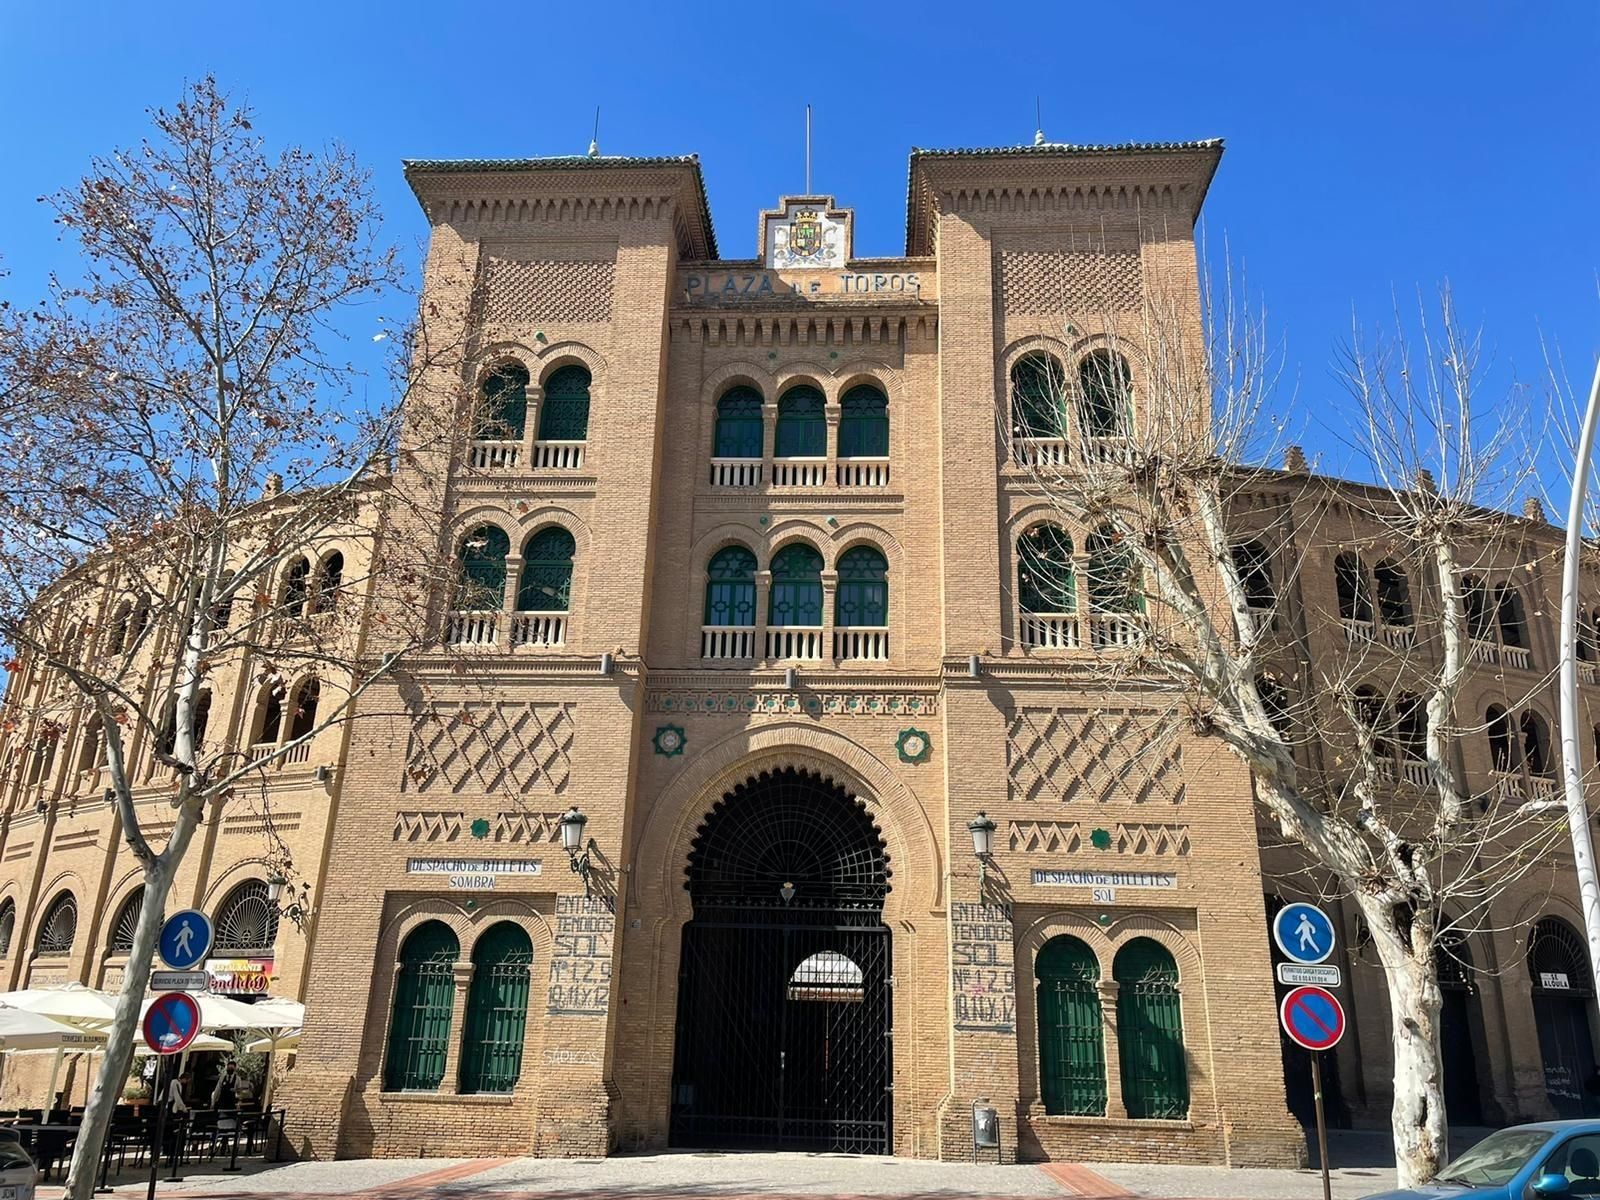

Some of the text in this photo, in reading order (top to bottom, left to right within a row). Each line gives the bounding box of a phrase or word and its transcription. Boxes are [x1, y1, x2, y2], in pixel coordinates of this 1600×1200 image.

[687, 274, 776, 299] PLAZA
[841, 273, 920, 293] TOROS
[412, 859, 466, 872] DESPACHO
[483, 860, 538, 872] BILLETES
[450, 876, 496, 889] SOMBRA
[1036, 871, 1094, 884] DESPACHO
[1111, 874, 1171, 886] BILLETES
[1094, 889, 1113, 902] SOL
[557, 917, 614, 932] TENDIDOS
[952, 925, 1013, 941] TENDIDOS
[553, 934, 611, 958] SOL
[952, 944, 1012, 966] SOL
